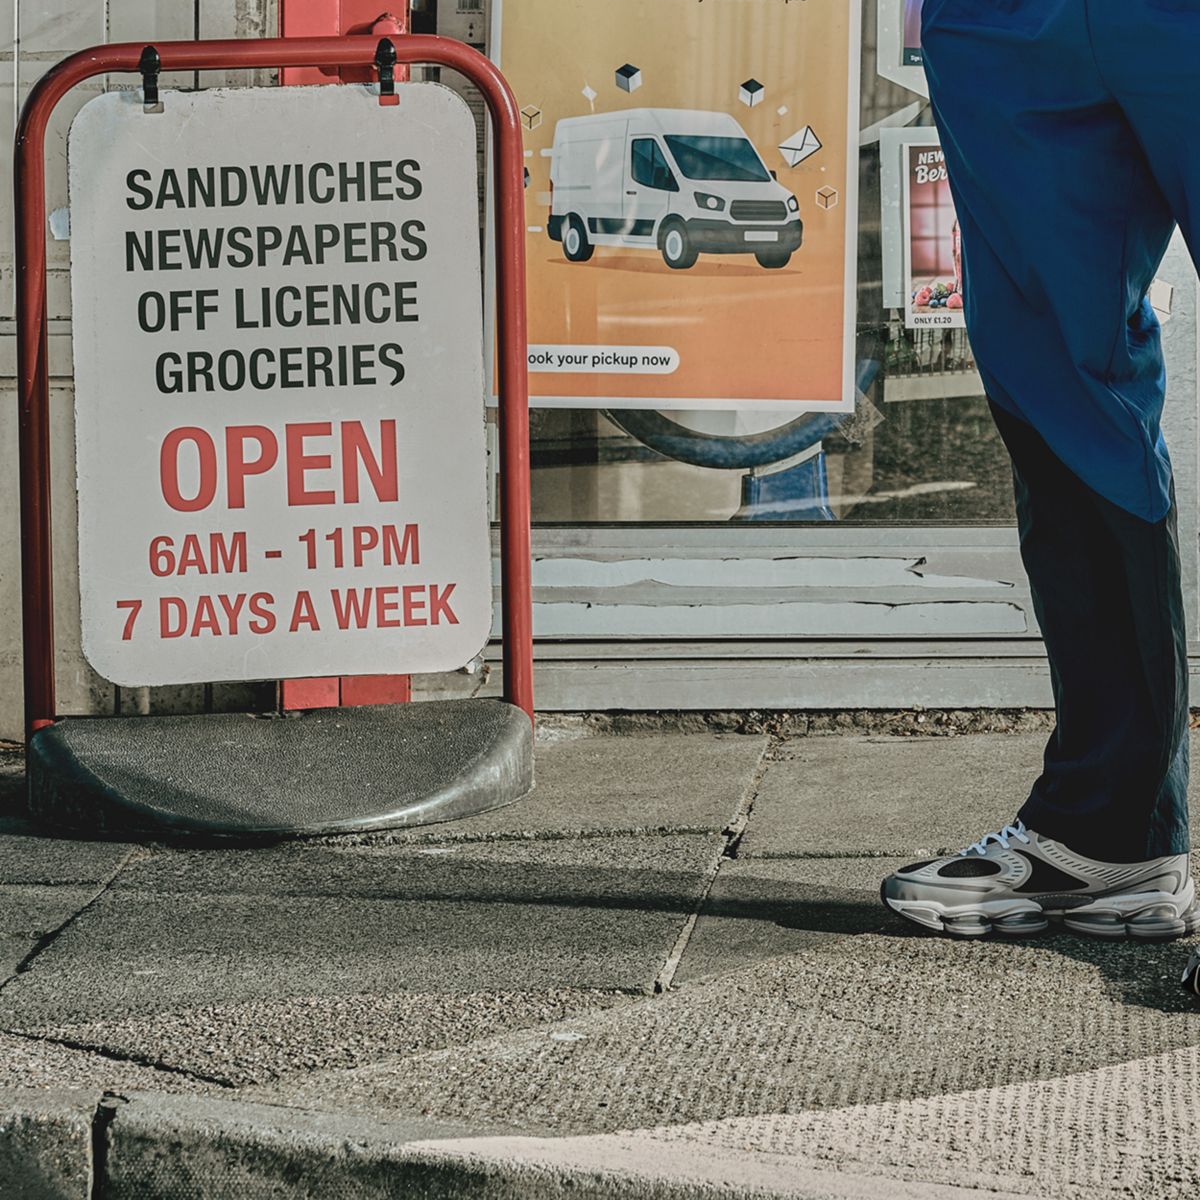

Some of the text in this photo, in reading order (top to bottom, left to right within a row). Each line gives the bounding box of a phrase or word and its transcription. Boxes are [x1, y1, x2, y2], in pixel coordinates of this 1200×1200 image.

[125, 159, 423, 211] SANDWICHES
[914, 164, 949, 185] Ber
[125, 220, 428, 272] NEWSPAPERS
[137, 281, 419, 333] OFF LICENCE
[914, 316, 952, 325] ONLY £1.20
[155, 343, 406, 394] GROCERIES
[527, 352, 671, 369] ook your pickup now
[160, 419, 399, 513] OPEN
[148, 524, 420, 578] 6AM - 11PM
[116, 583, 460, 641] 7 DAYS A WEEK
